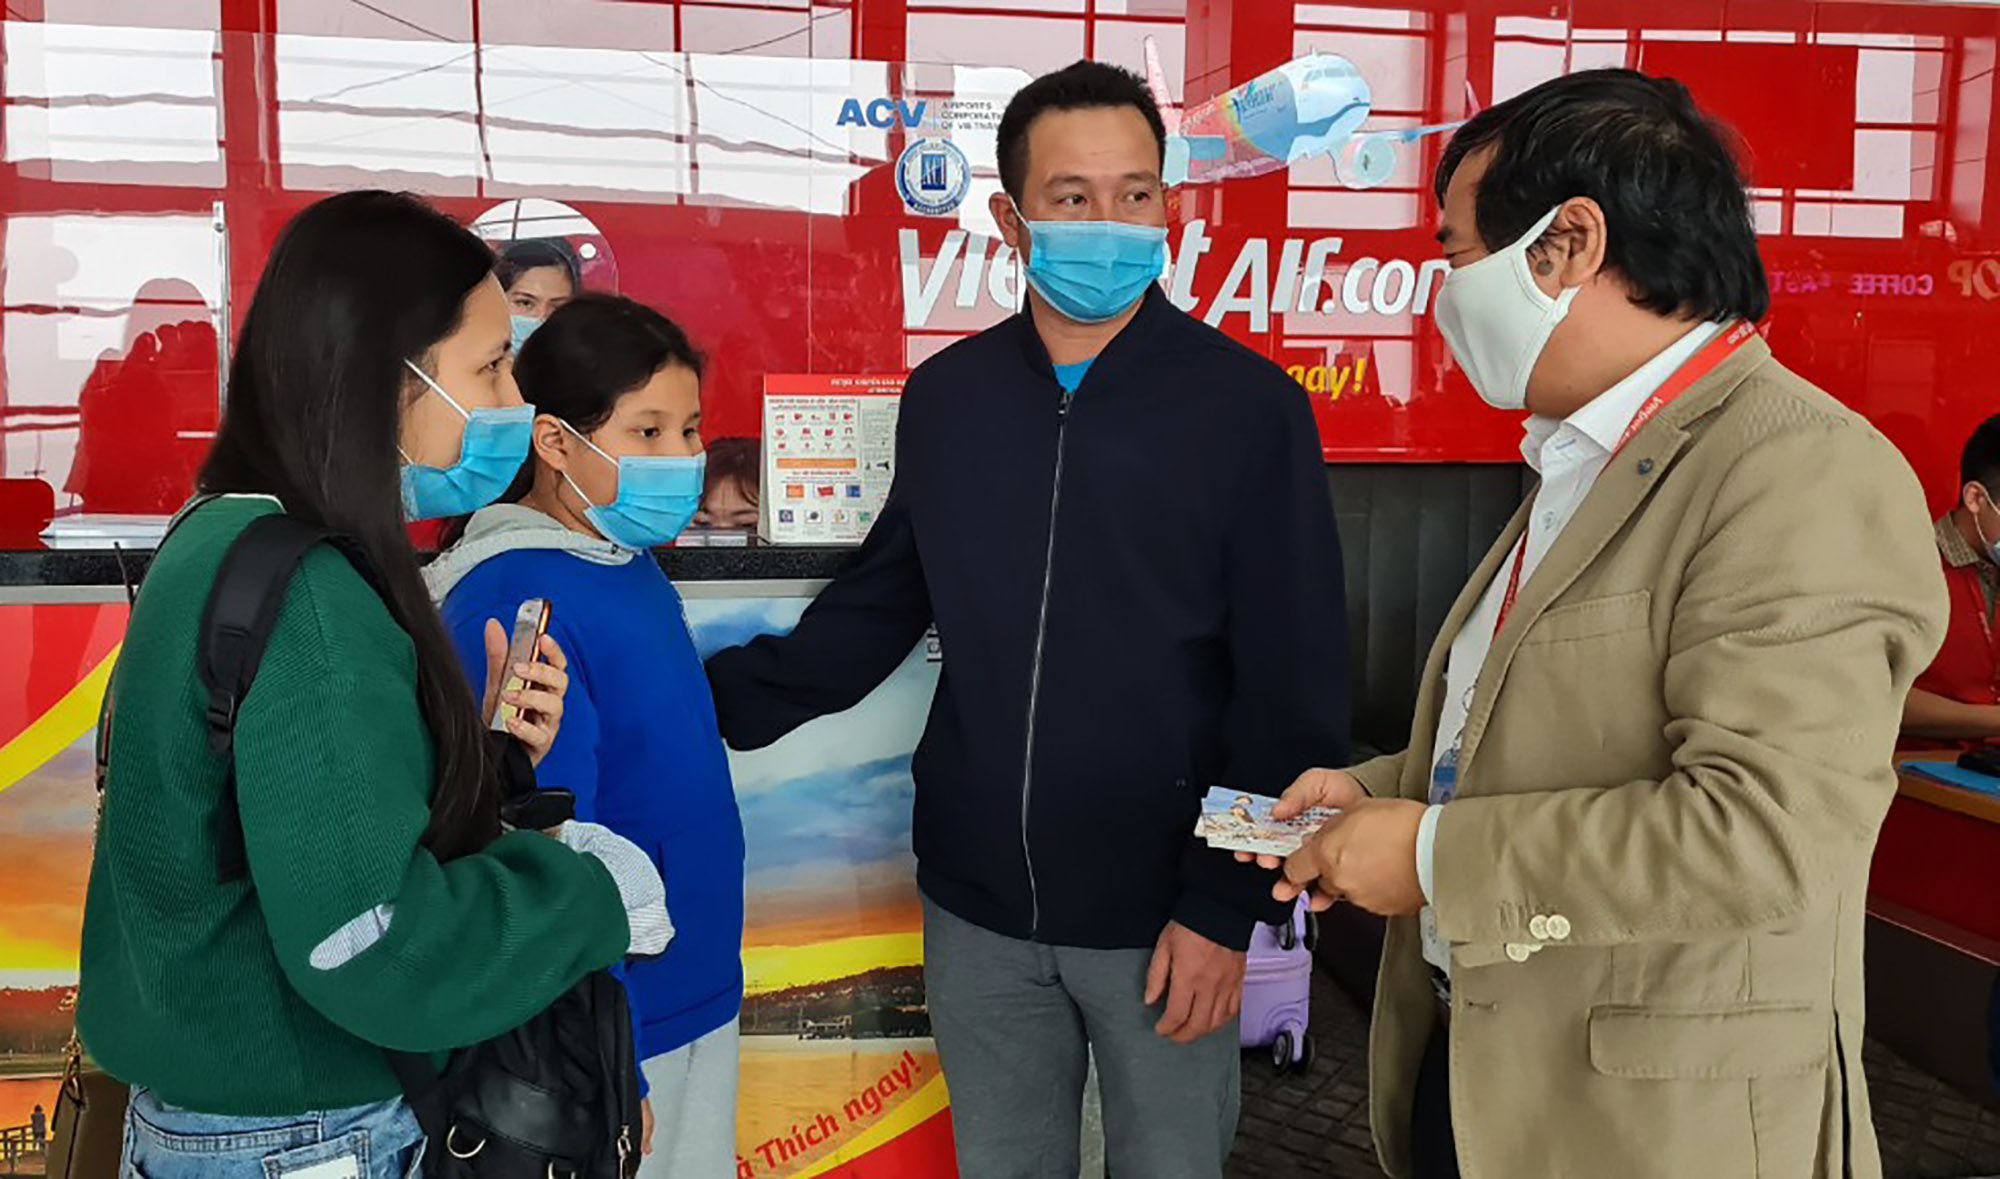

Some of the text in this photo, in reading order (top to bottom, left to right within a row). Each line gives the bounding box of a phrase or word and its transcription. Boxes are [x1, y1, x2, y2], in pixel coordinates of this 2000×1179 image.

[836, 98, 927, 128] ACV
[941, 102, 992, 110] AIRPORTS
[941, 111, 1002, 120] CORPORATI
[843, 1049, 921, 1122] ngay!
